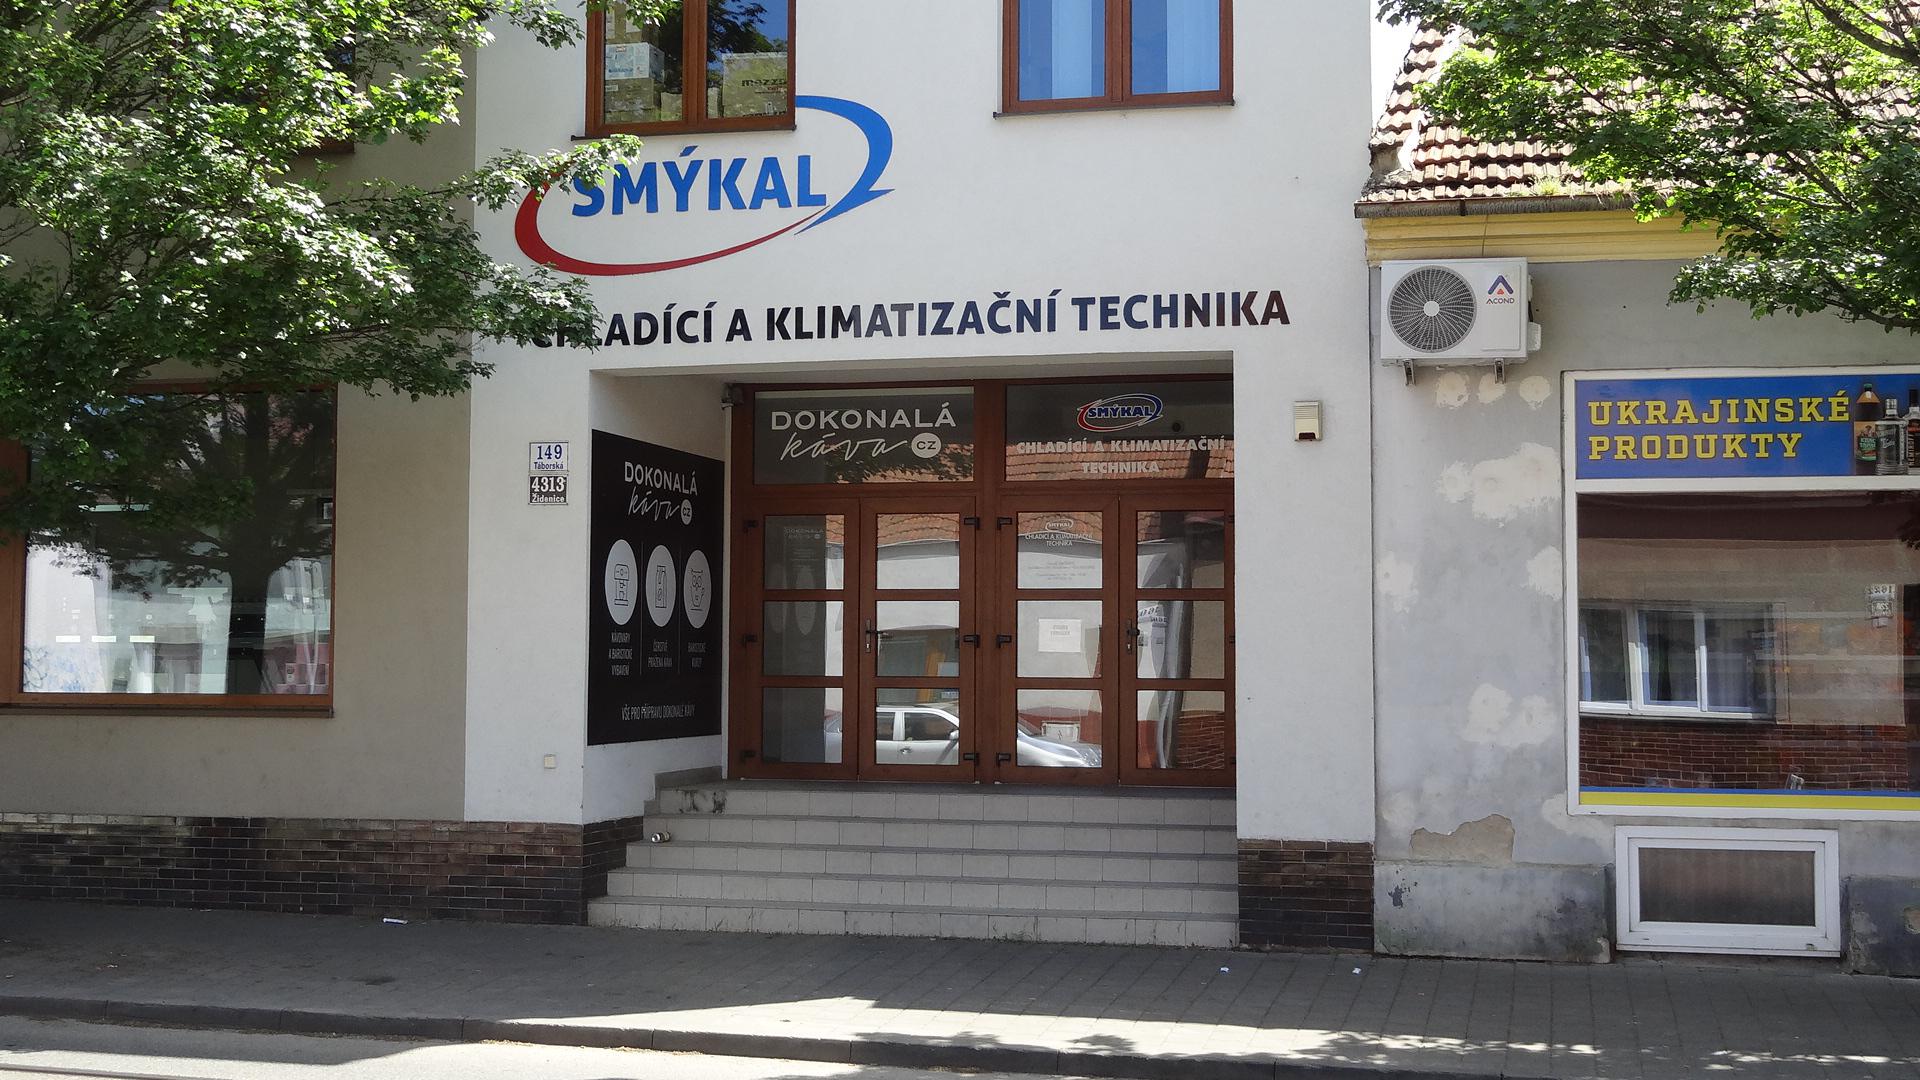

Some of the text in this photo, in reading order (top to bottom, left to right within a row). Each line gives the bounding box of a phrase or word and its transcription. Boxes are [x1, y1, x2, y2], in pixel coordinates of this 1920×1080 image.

[571, 145, 827, 217] SMÝKAL
[1486, 297, 1515, 305] ACOND
[725, 308, 752, 342] A
[766, 288, 1063, 340] KLIMATIZAČNÍ
[1072, 290, 1290, 331] TECHNIKA
[772, 402, 957, 430] DOKONALÁ
[1087, 404, 1153, 419] SMÝKAL
[1588, 390, 1850, 426] UKRAJINSKÉ
[537, 444, 563, 460] 149
[780, 432, 908, 461] káva
[1017, 435, 1225, 454] CHLADÍCÍ A KLIMATIZAČNÍ
[1588, 433, 1803, 461] PRODUKTY
[533, 461, 564, 470] Táborská
[1081, 461, 1161, 474] TECHNIKA
[531, 476, 566, 492] 4313
[624, 461, 698, 497] DOKONALÁ
[531, 492, 565, 503] Židenice
[628, 486, 680, 521] káva
